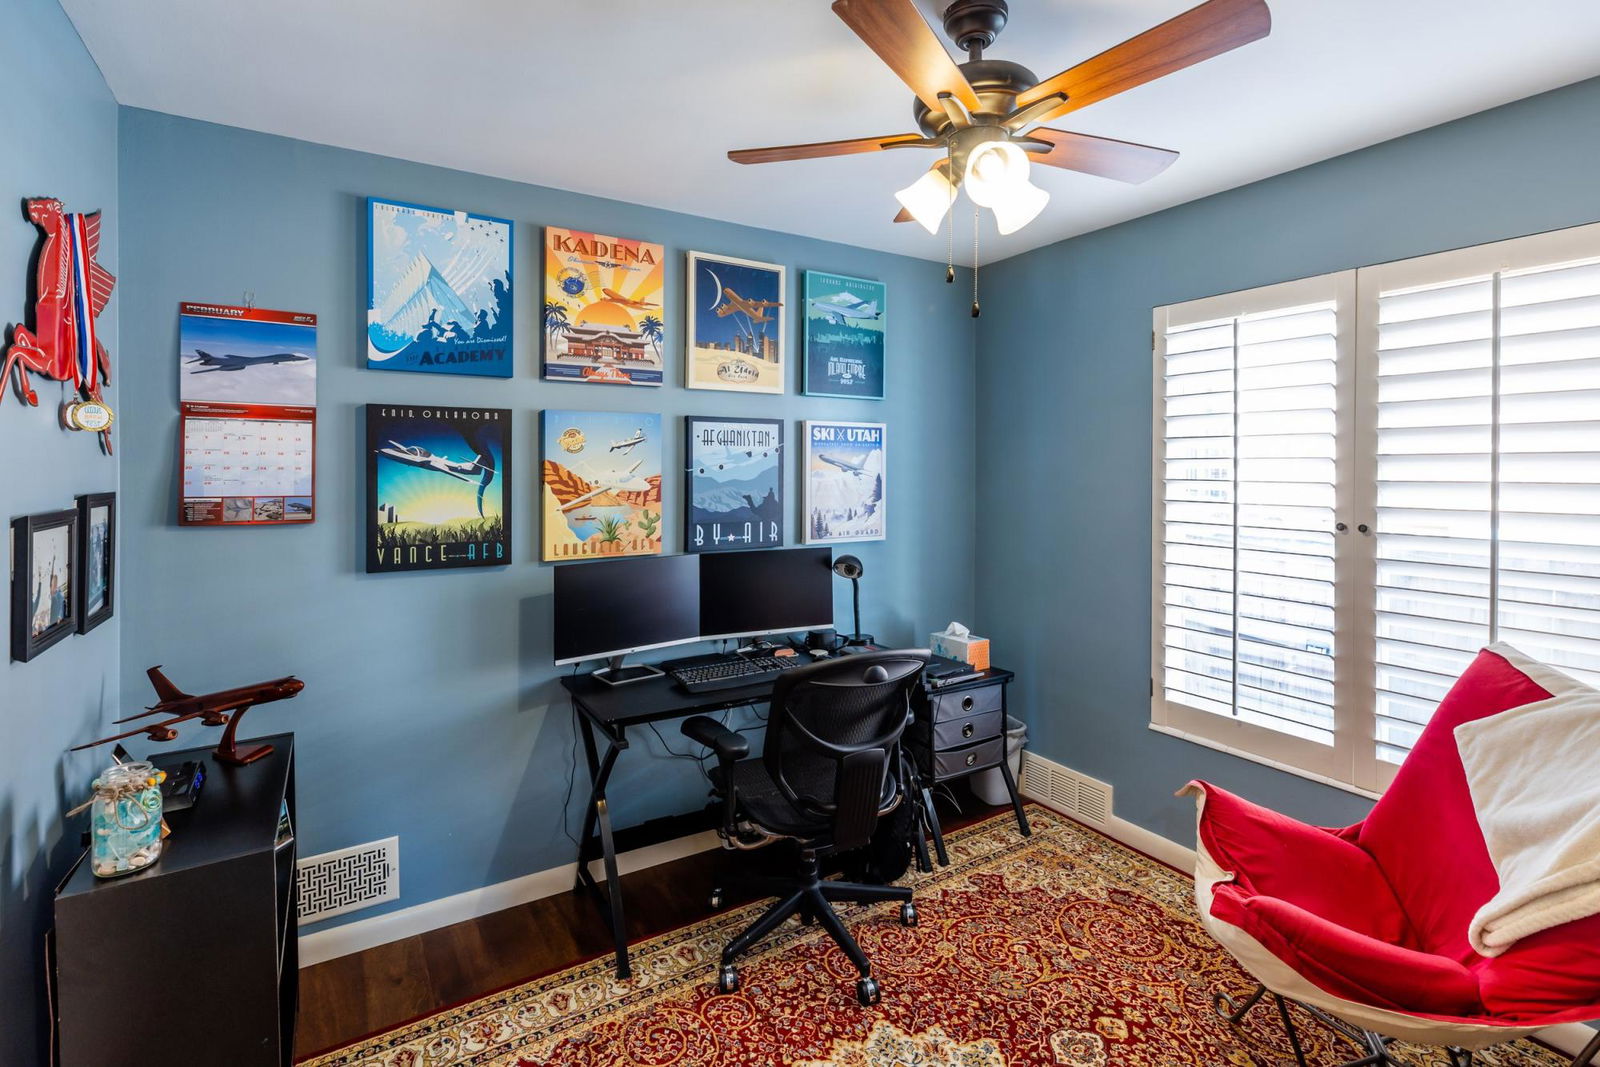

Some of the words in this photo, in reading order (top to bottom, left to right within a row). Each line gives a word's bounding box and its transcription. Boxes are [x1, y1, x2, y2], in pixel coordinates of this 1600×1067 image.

[553, 234, 656, 265] KADENA
[186, 304, 244, 317] FEBRUARY
[454, 337, 464, 345] You
[419, 348, 505, 367] ACADEMY
[422, 410, 499, 420] OKLAHOMA
[702, 429, 770, 447] AFGHANISTAN
[812, 427, 835, 441] SKI
[847, 428, 880, 442] UTAH
[694, 523, 721, 546] BY
[742, 521, 778, 543] AIR
[377, 544, 447, 565] VANCE
[467, 541, 503, 561] AFB
